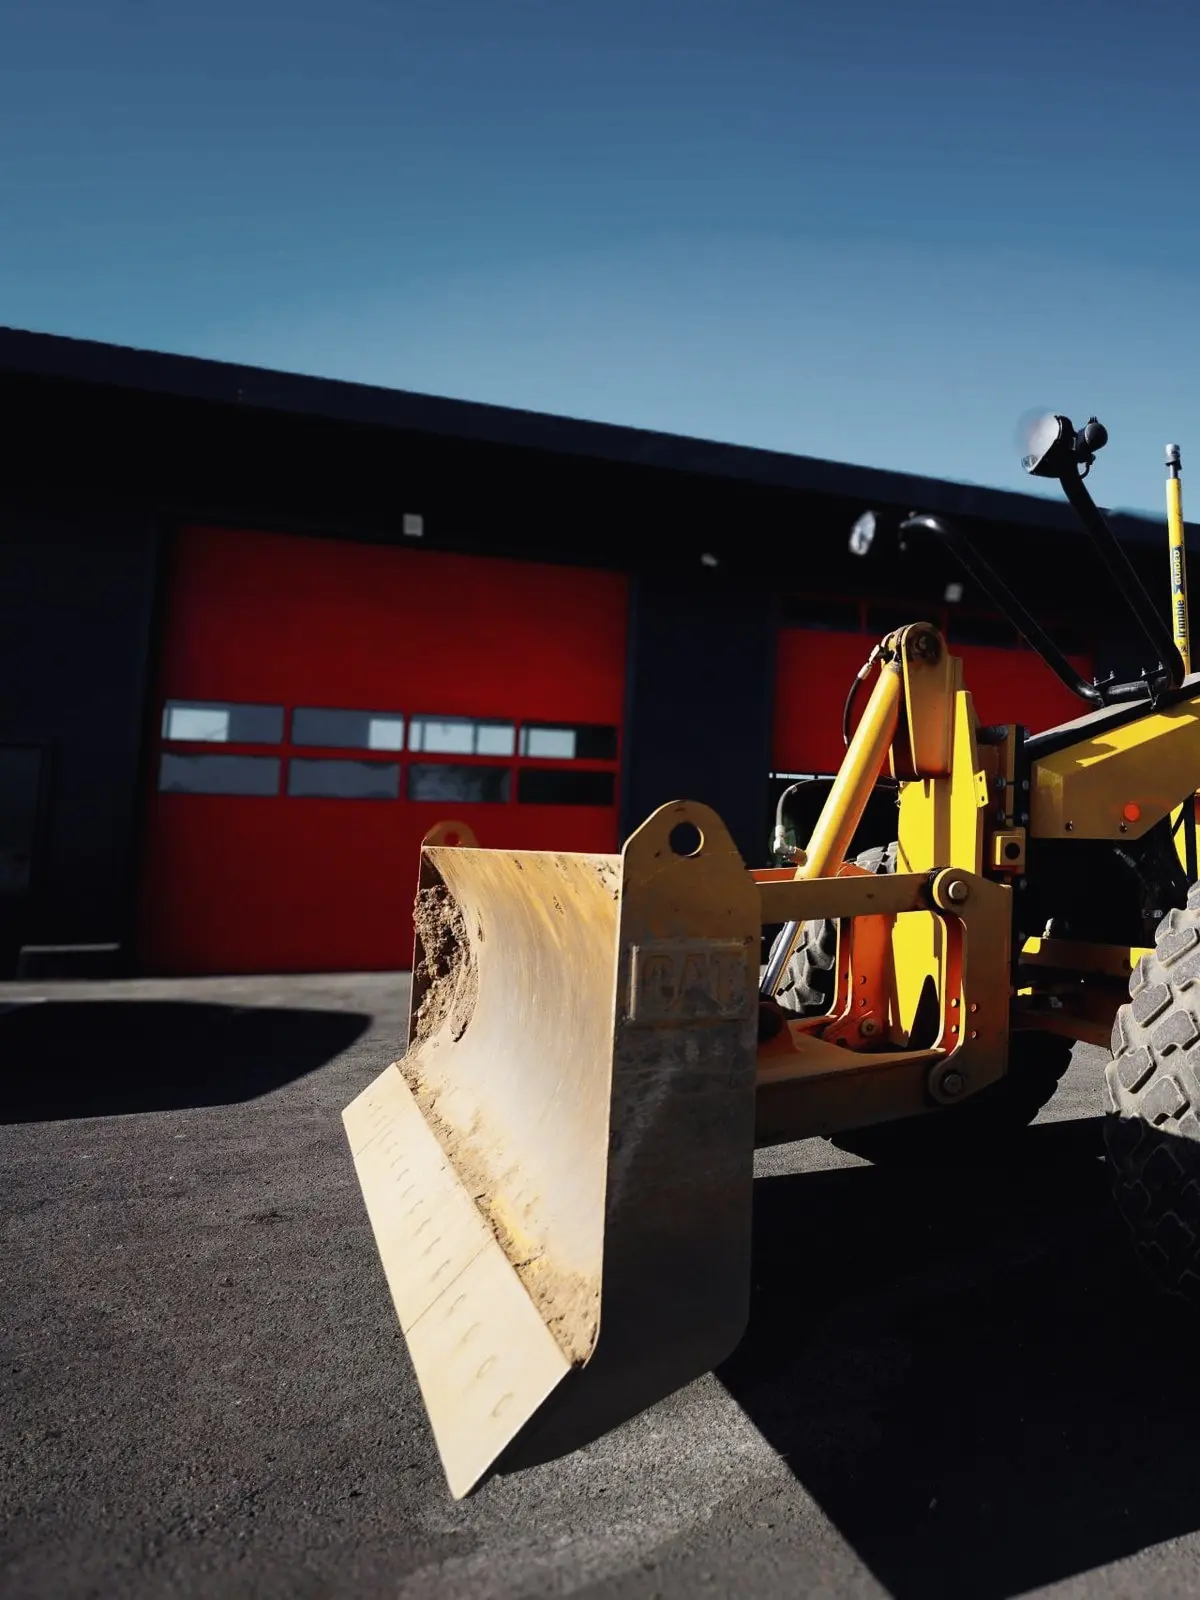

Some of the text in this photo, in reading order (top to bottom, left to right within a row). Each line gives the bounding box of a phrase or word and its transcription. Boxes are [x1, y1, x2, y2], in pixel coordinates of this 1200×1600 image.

[1174, 550, 1186, 638] Trimble GUIDED
[641, 952, 744, 1014] CAT
